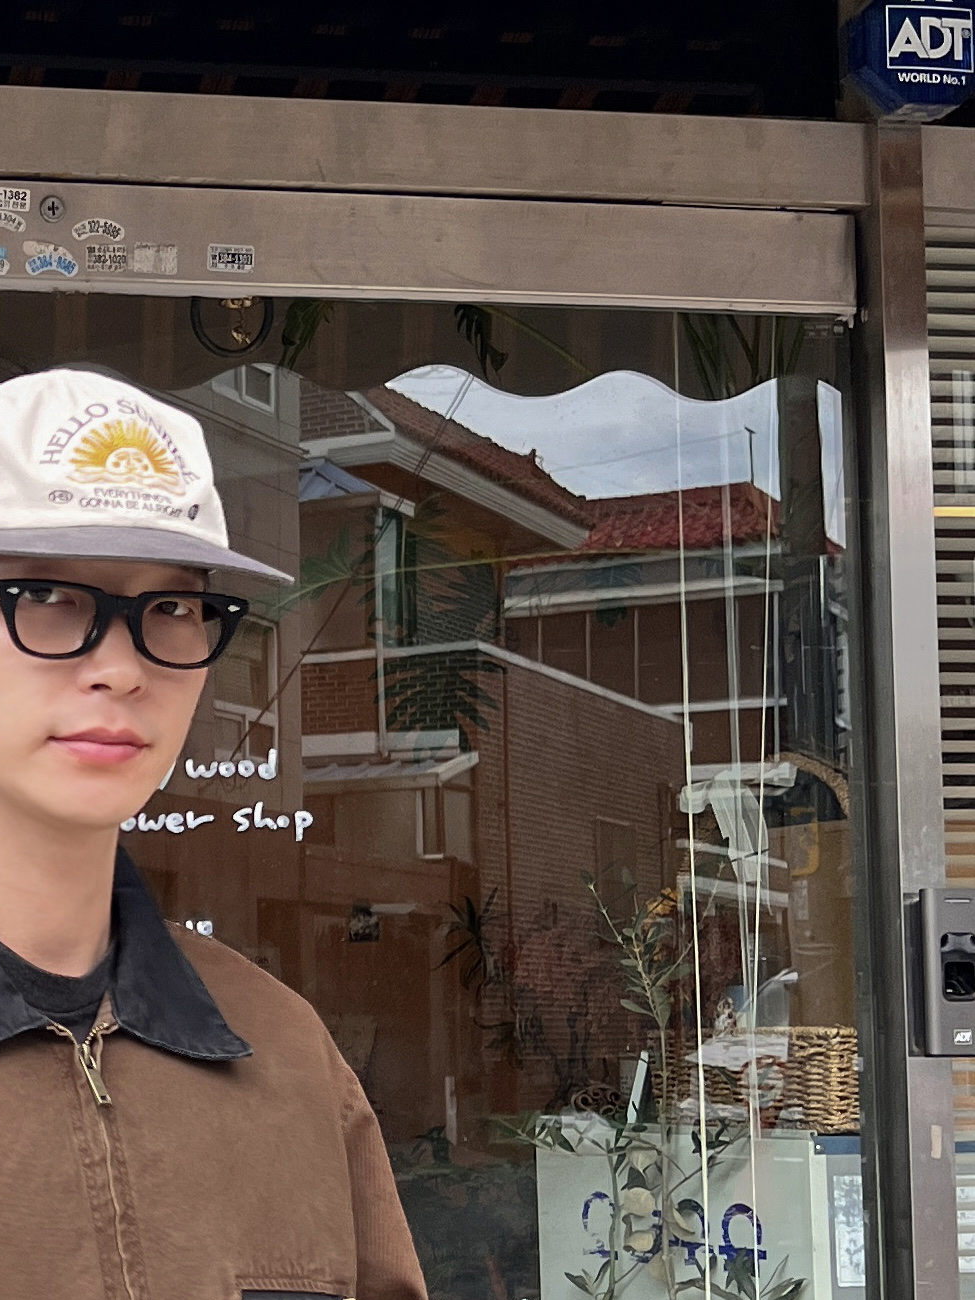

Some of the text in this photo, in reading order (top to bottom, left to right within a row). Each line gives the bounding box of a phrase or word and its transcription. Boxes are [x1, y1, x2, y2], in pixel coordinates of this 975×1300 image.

[888, 16, 971, 61] ADT
[897, 72, 966, 86] WORLD No.1
[38, 402, 109, 466] HELLO
[185, 747, 279, 781] wood
[232, 801, 314, 842] shop
